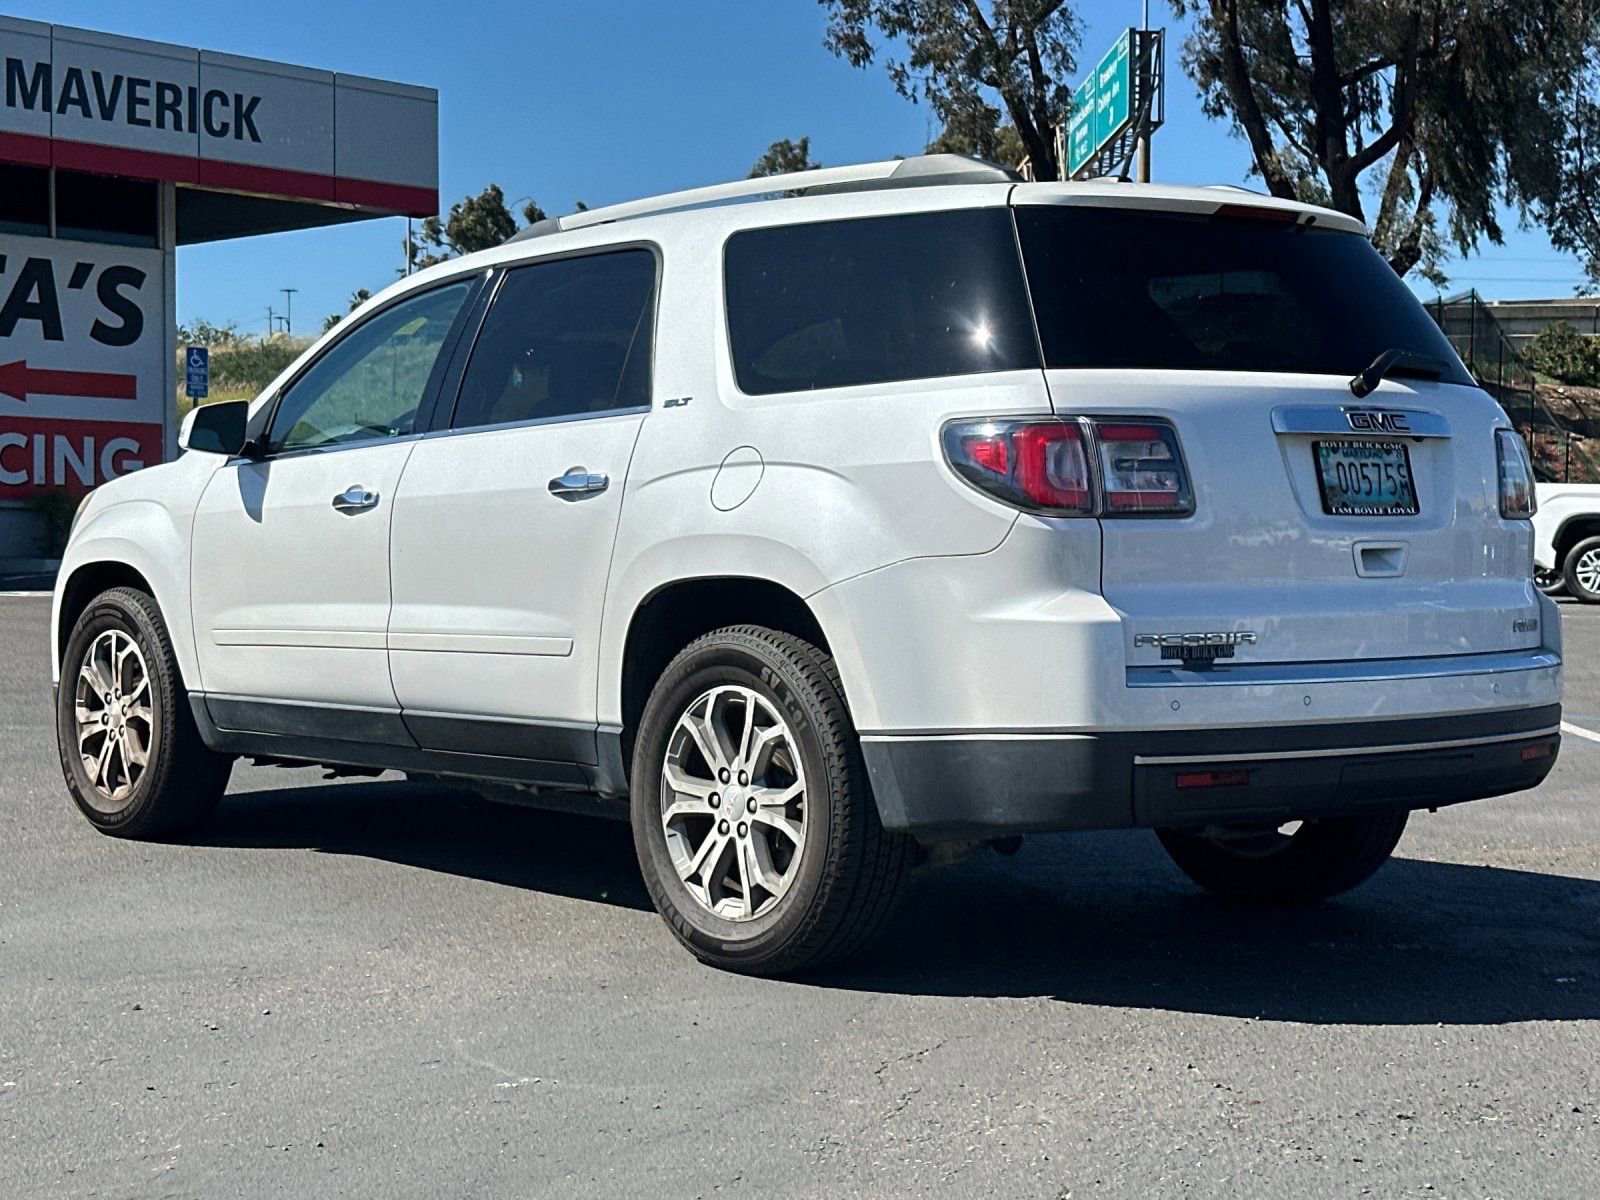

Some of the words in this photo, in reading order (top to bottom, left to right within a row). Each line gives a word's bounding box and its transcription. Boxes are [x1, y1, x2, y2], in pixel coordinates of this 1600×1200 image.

[5, 57, 262, 144] MAVERICK
[0, 254, 147, 347] A'S
[663, 396, 693, 408] SLT
[1346, 411, 1411, 432] GMC
[1320, 441, 1348, 449] BOYLE
[1352, 441, 1382, 449] BUICK
[1342, 448, 1384, 459] MARYLAND
[1336, 462, 1396, 496] 00575
[1387, 507, 1418, 515] LOYAL
[1134, 630, 1257, 647] ACADIA
